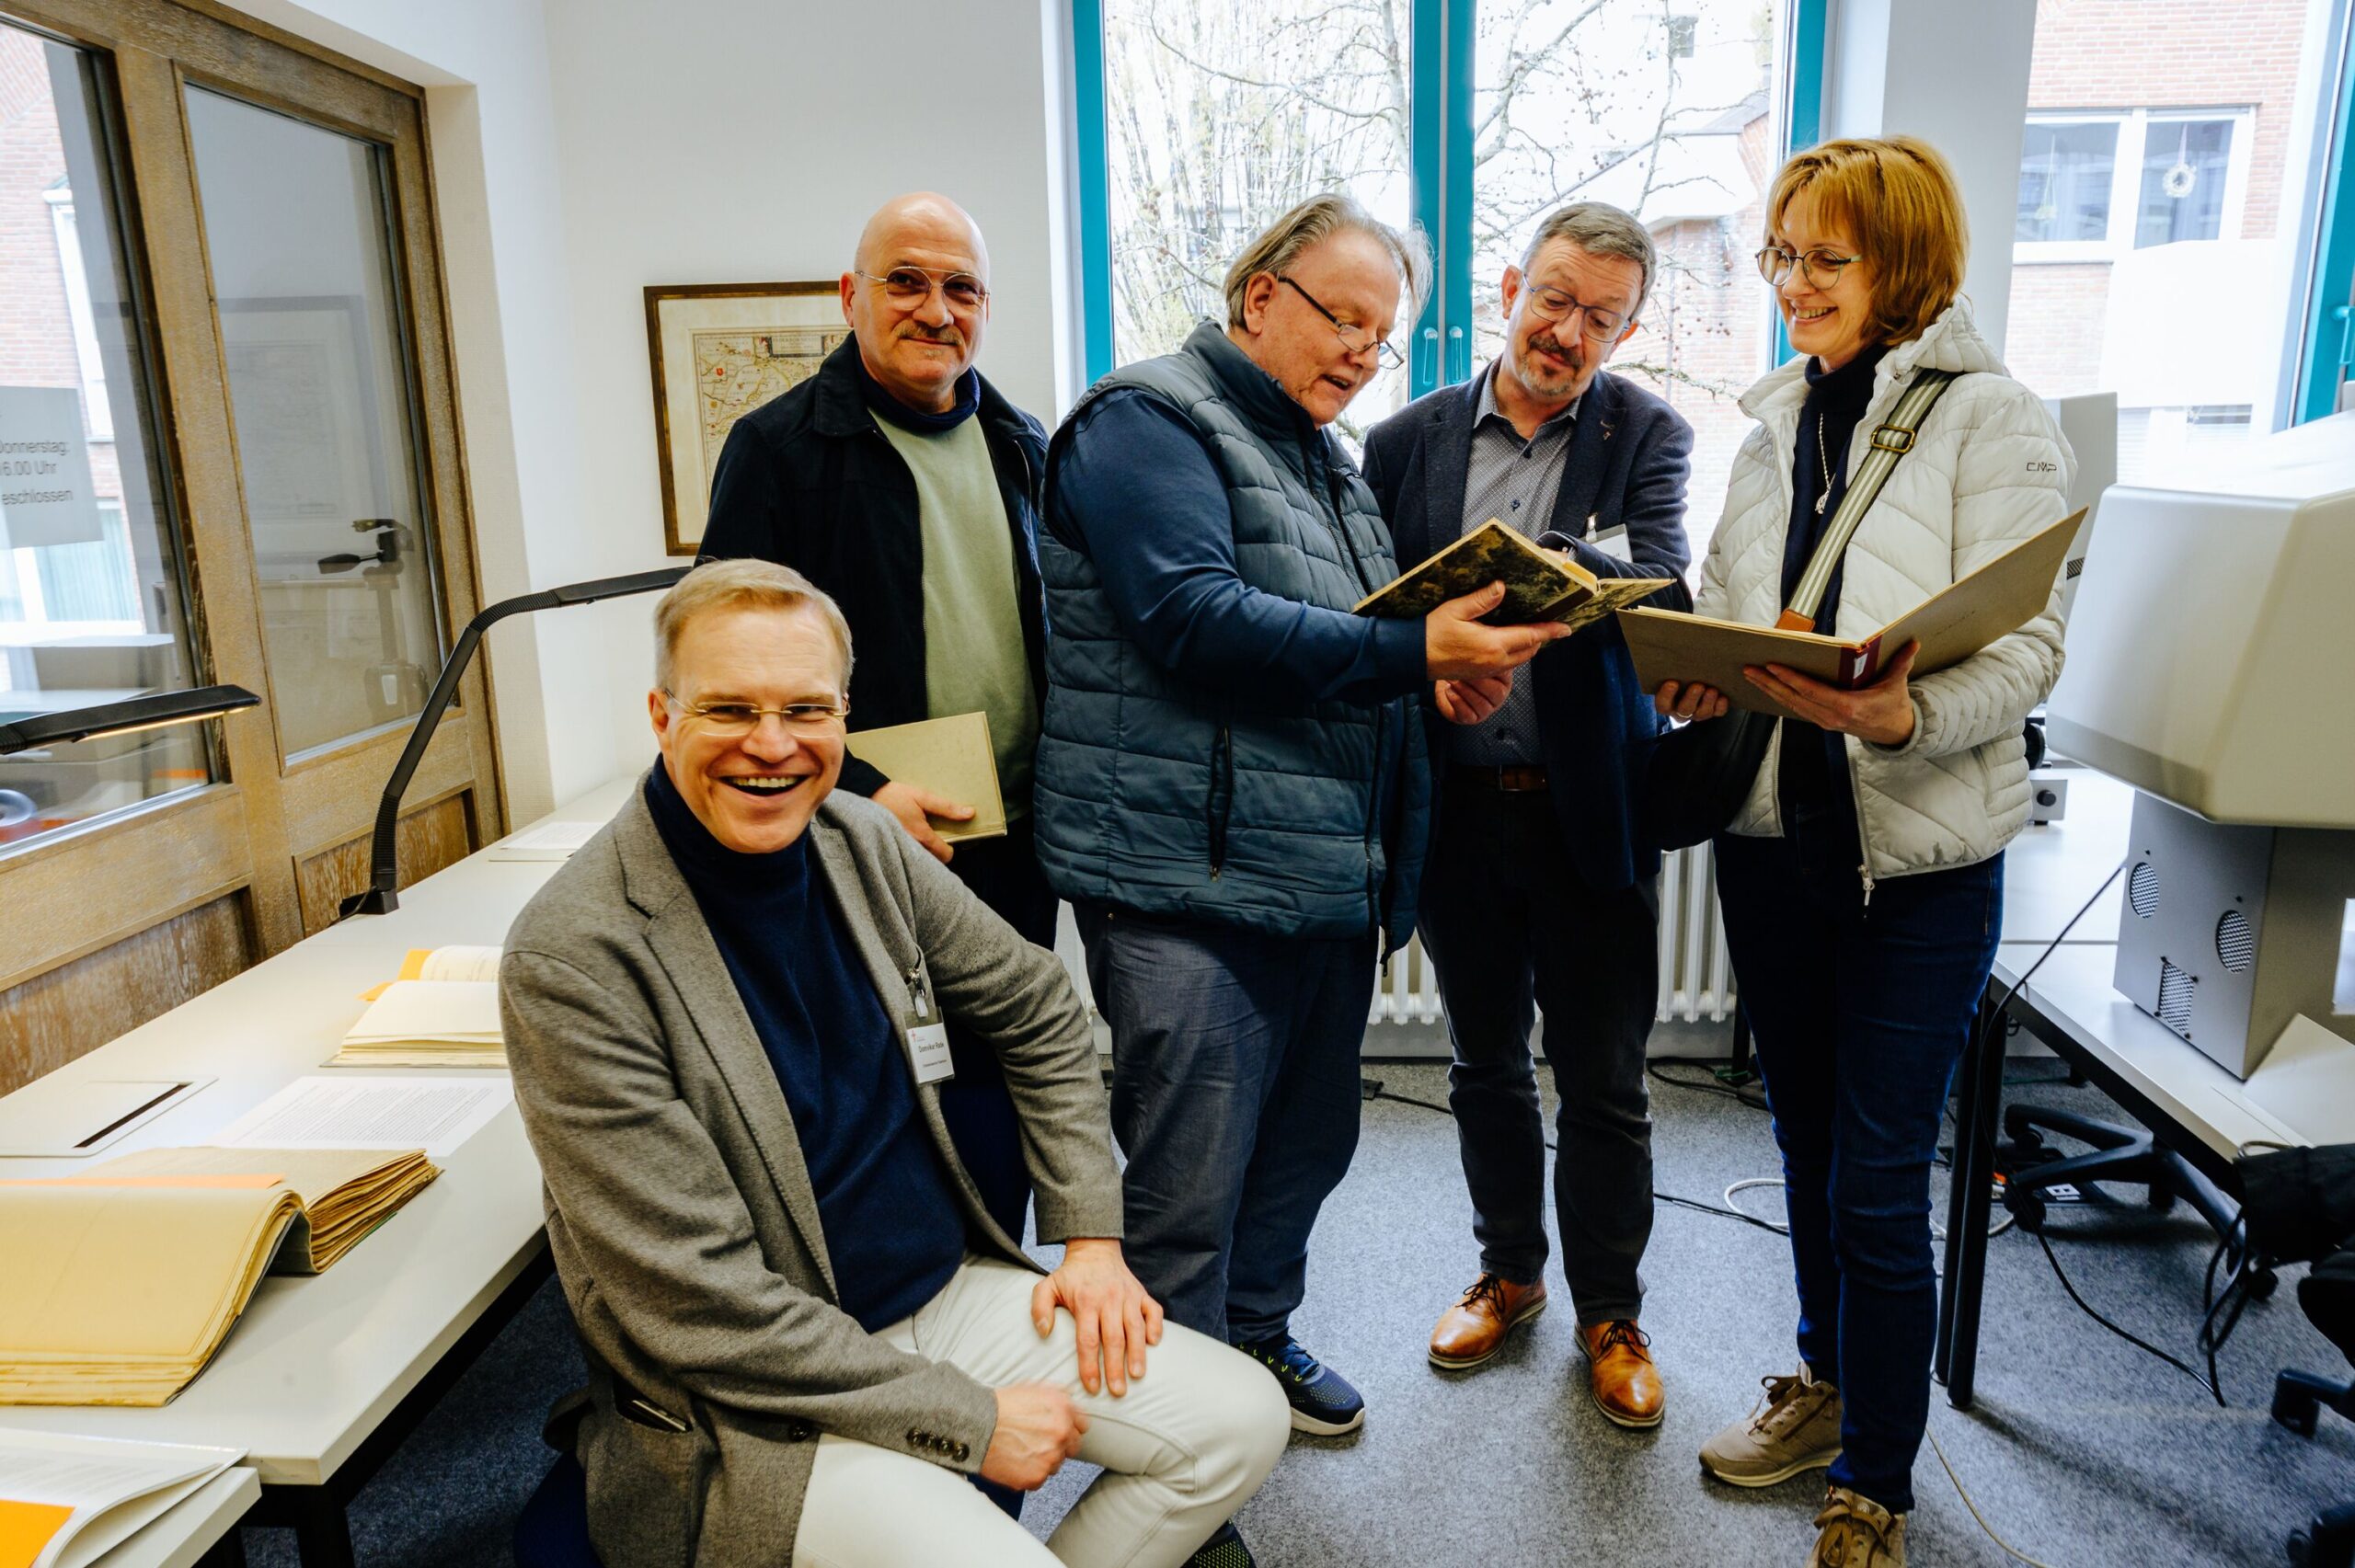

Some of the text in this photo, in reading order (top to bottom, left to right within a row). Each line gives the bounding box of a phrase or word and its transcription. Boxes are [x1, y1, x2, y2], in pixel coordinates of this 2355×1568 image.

[35, 460, 57, 475] Uhr
[2026, 462, 2057, 473] CMP
[1, 488, 74, 505] eschlossen
